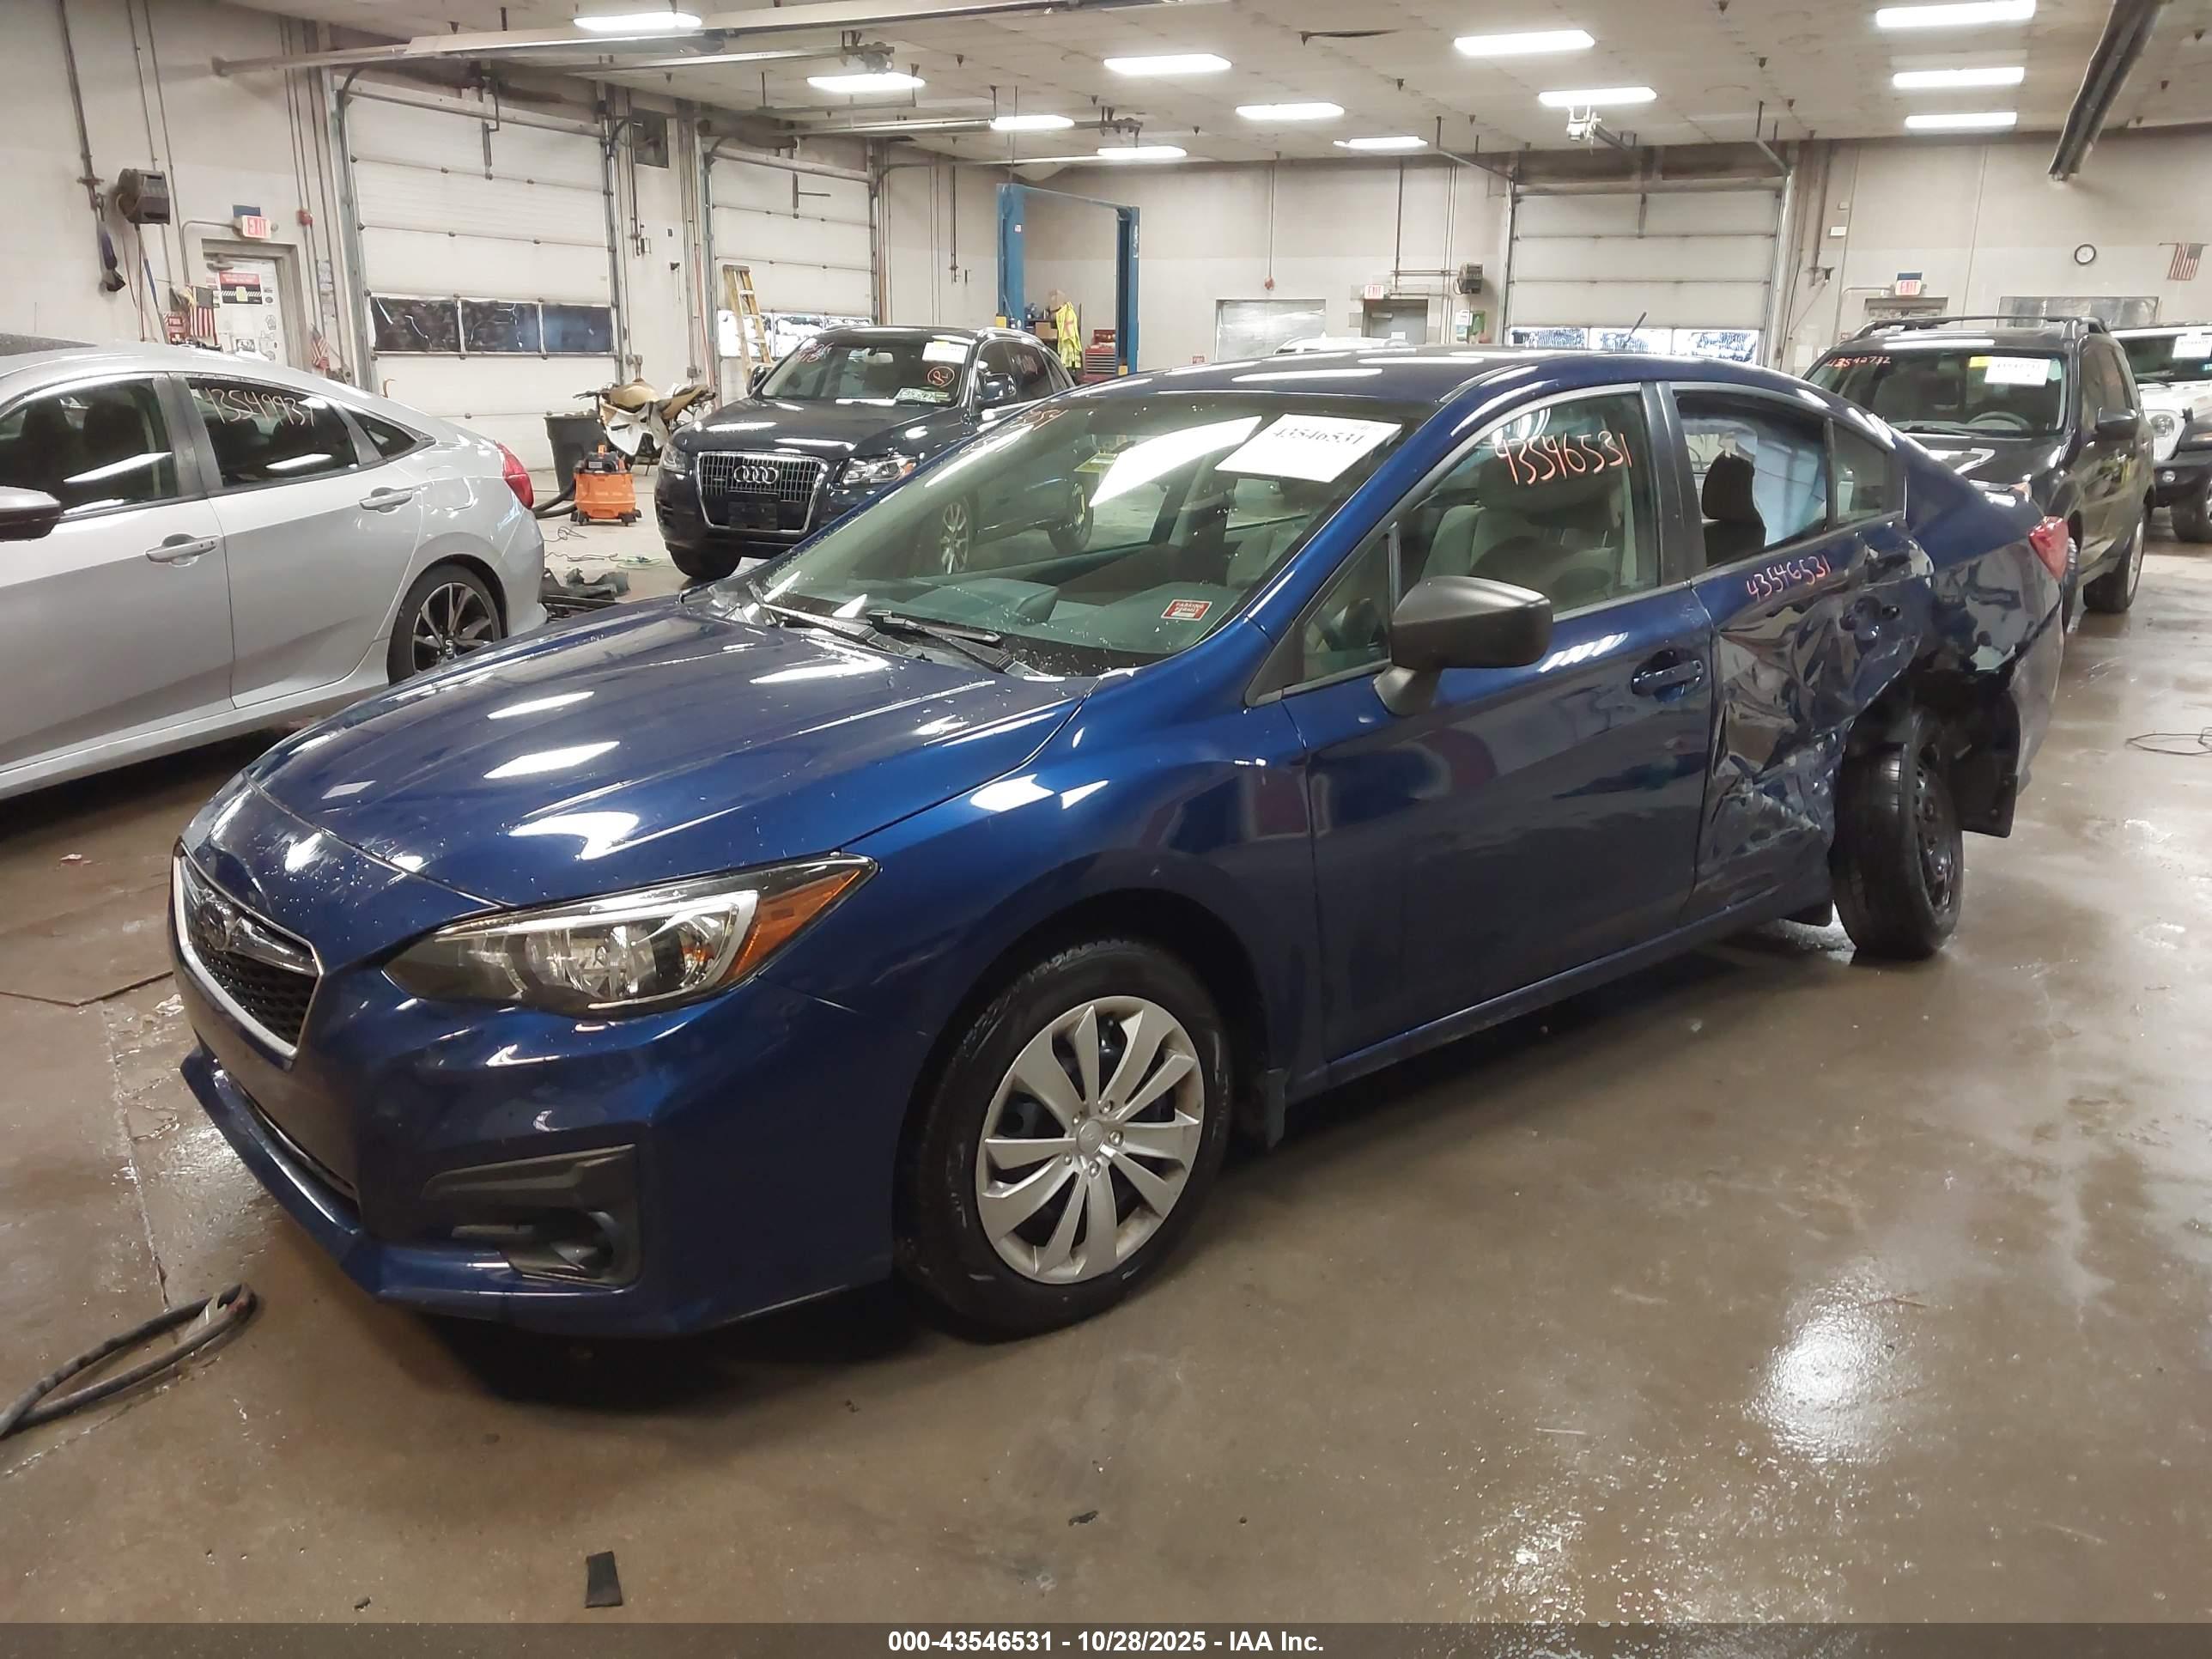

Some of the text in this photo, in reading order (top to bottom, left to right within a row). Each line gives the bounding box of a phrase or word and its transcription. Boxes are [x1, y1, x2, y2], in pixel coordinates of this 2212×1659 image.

[246, 217, 269, 237] EXIT
[1368, 285, 1382, 296] EXIT
[1900, 281, 1918, 294] EXIT
[1273, 428, 1365, 445] 43546531
[1494, 430, 1632, 485] 43546531
[1746, 554, 1832, 602] 43546531
